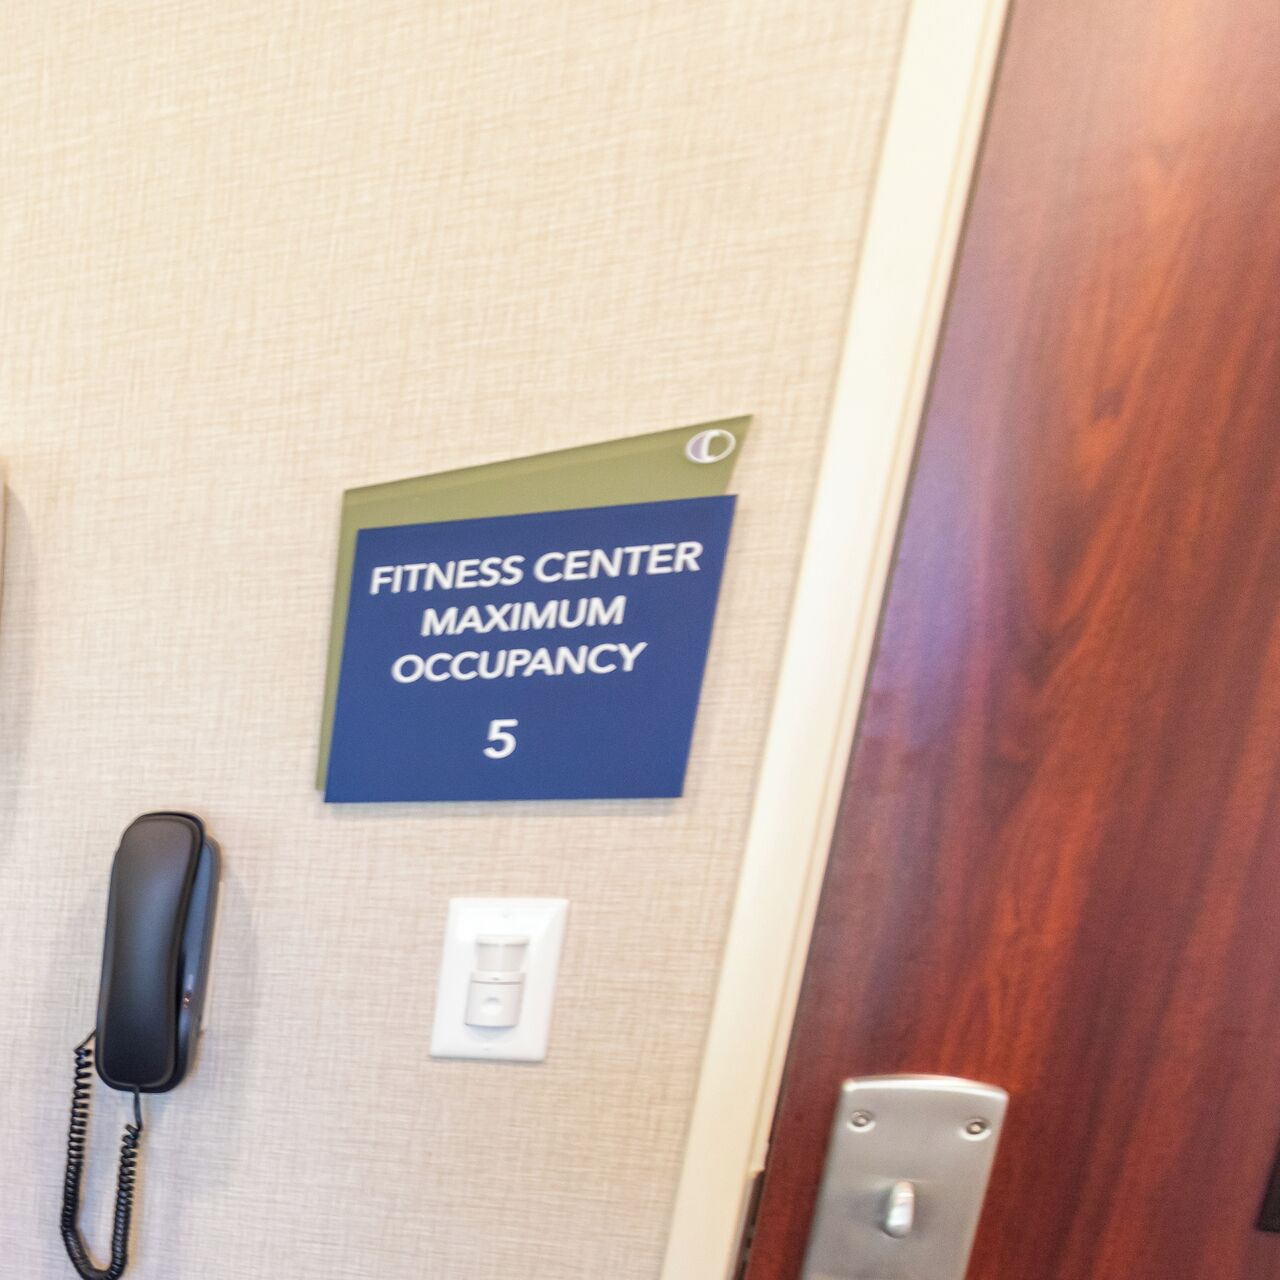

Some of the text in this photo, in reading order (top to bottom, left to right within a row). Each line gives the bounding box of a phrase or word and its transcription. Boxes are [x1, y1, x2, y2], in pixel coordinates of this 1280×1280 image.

[370, 541, 703, 595] FITNESS CENTER
[420, 596, 627, 637] MAXIMUM
[391, 642, 648, 684] OCCUPANCY
[483, 719, 519, 759] 5
